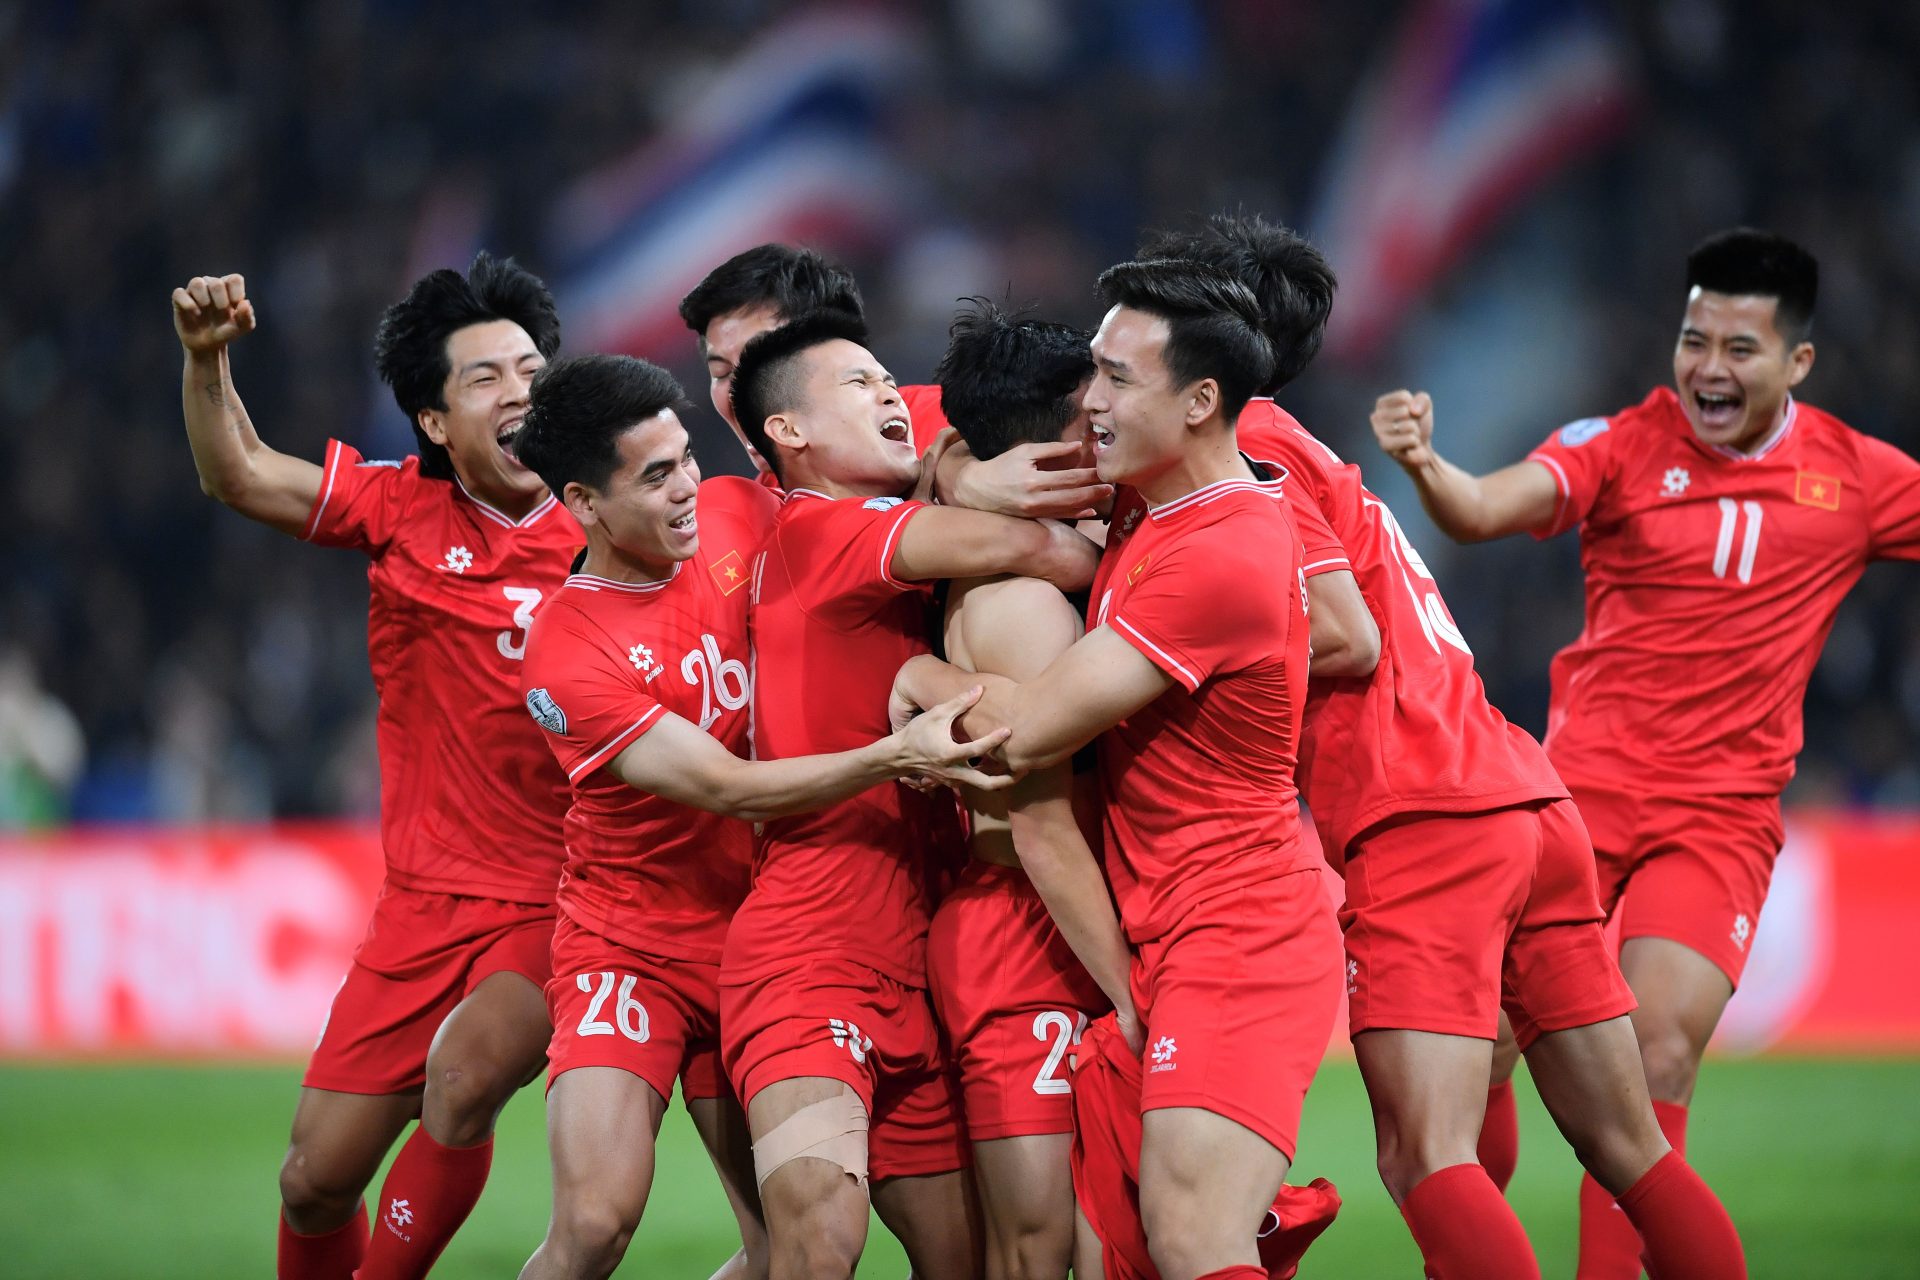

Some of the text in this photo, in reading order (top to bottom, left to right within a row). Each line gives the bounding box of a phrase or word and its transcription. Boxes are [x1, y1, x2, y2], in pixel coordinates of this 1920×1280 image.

[1712, 497, 1763, 585] 11
[497, 586, 543, 660] 3
[681, 634, 749, 732] 26
[577, 971, 650, 1044] 26
